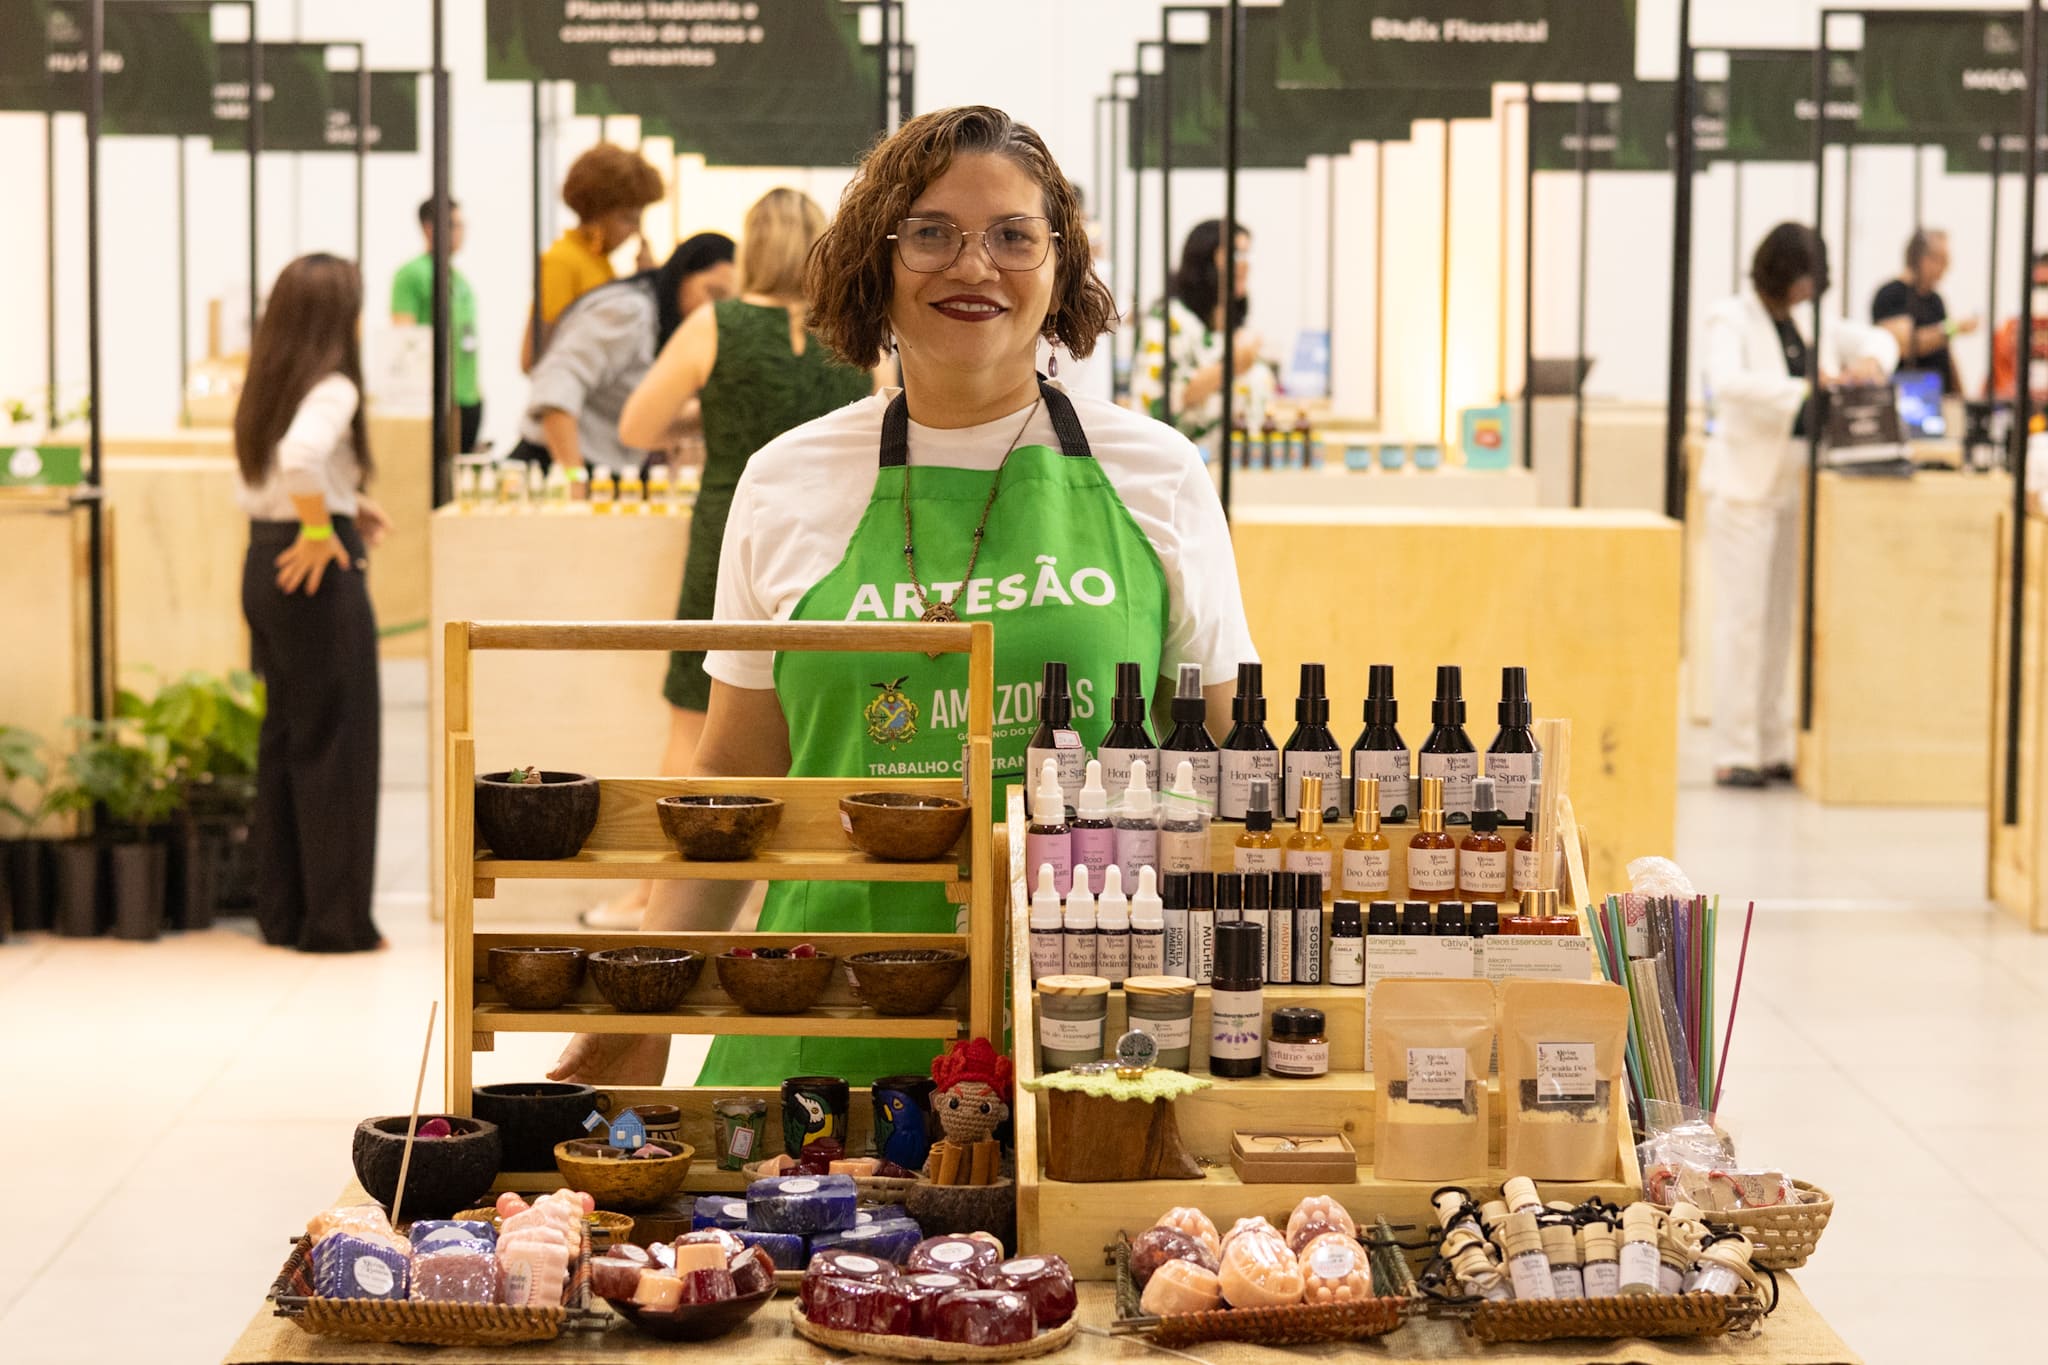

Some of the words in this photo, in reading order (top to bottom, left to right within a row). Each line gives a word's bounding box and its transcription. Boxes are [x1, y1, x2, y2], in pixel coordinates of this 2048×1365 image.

[743, 2, 759, 20] e
[659, 23, 688, 43] de
[748, 26, 765, 43] e
[1443, 18, 1548, 42] Florestal
[845, 555, 1117, 622] ARTESÃO
[1010, 727, 1025, 738] DO
[868, 761, 949, 775] TRABALHO
[1497, 773, 1527, 784] Spray
[1168, 927, 1176, 967] PIMENTA
[1203, 926, 1213, 978] MULHER
[1281, 923, 1290, 981] IMUNIDADE
[1441, 938, 1469, 948] Cativa
[1558, 939, 1586, 948] Cativa
[1309, 926, 1319, 983] SOSSEGO
